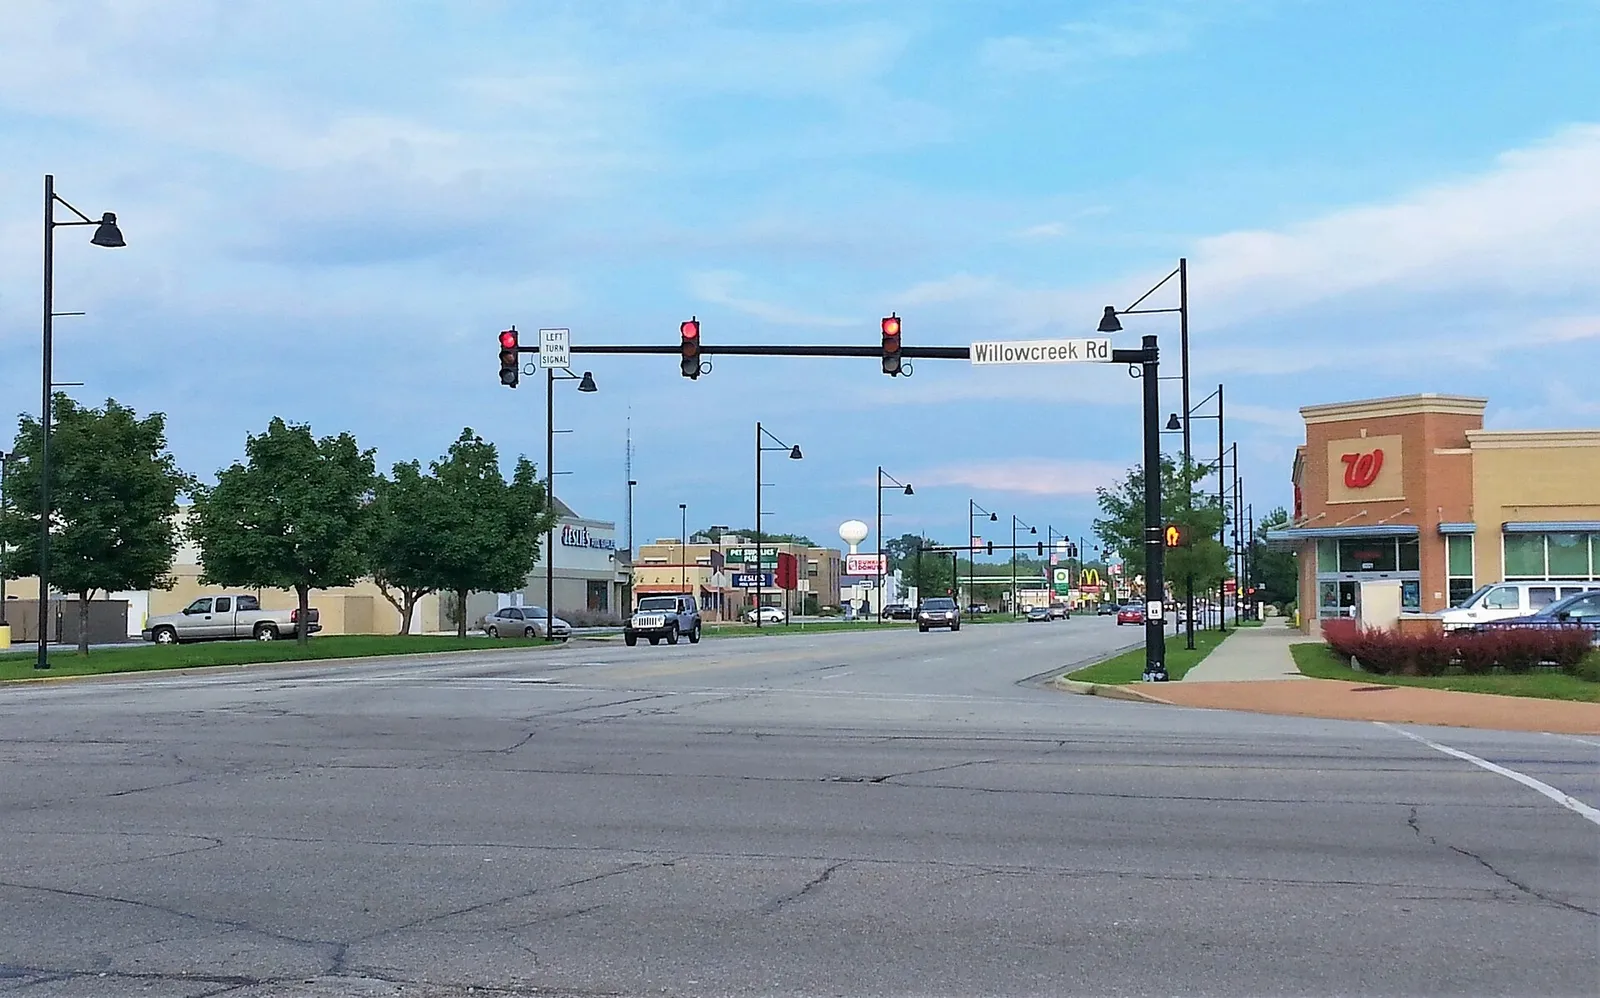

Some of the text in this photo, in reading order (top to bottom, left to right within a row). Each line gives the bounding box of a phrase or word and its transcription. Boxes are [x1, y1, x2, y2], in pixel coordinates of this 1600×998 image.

[545, 333, 563, 341] LEFT
[545, 344, 564, 352] TURN
[975, 341, 1107, 362] Willowcreek Rd
[542, 355, 568, 364] SIGNAL
[1341, 448, 1384, 488] W
[743, 548, 775, 556] SUPLIES
[738, 573, 766, 582] LESLI'S
